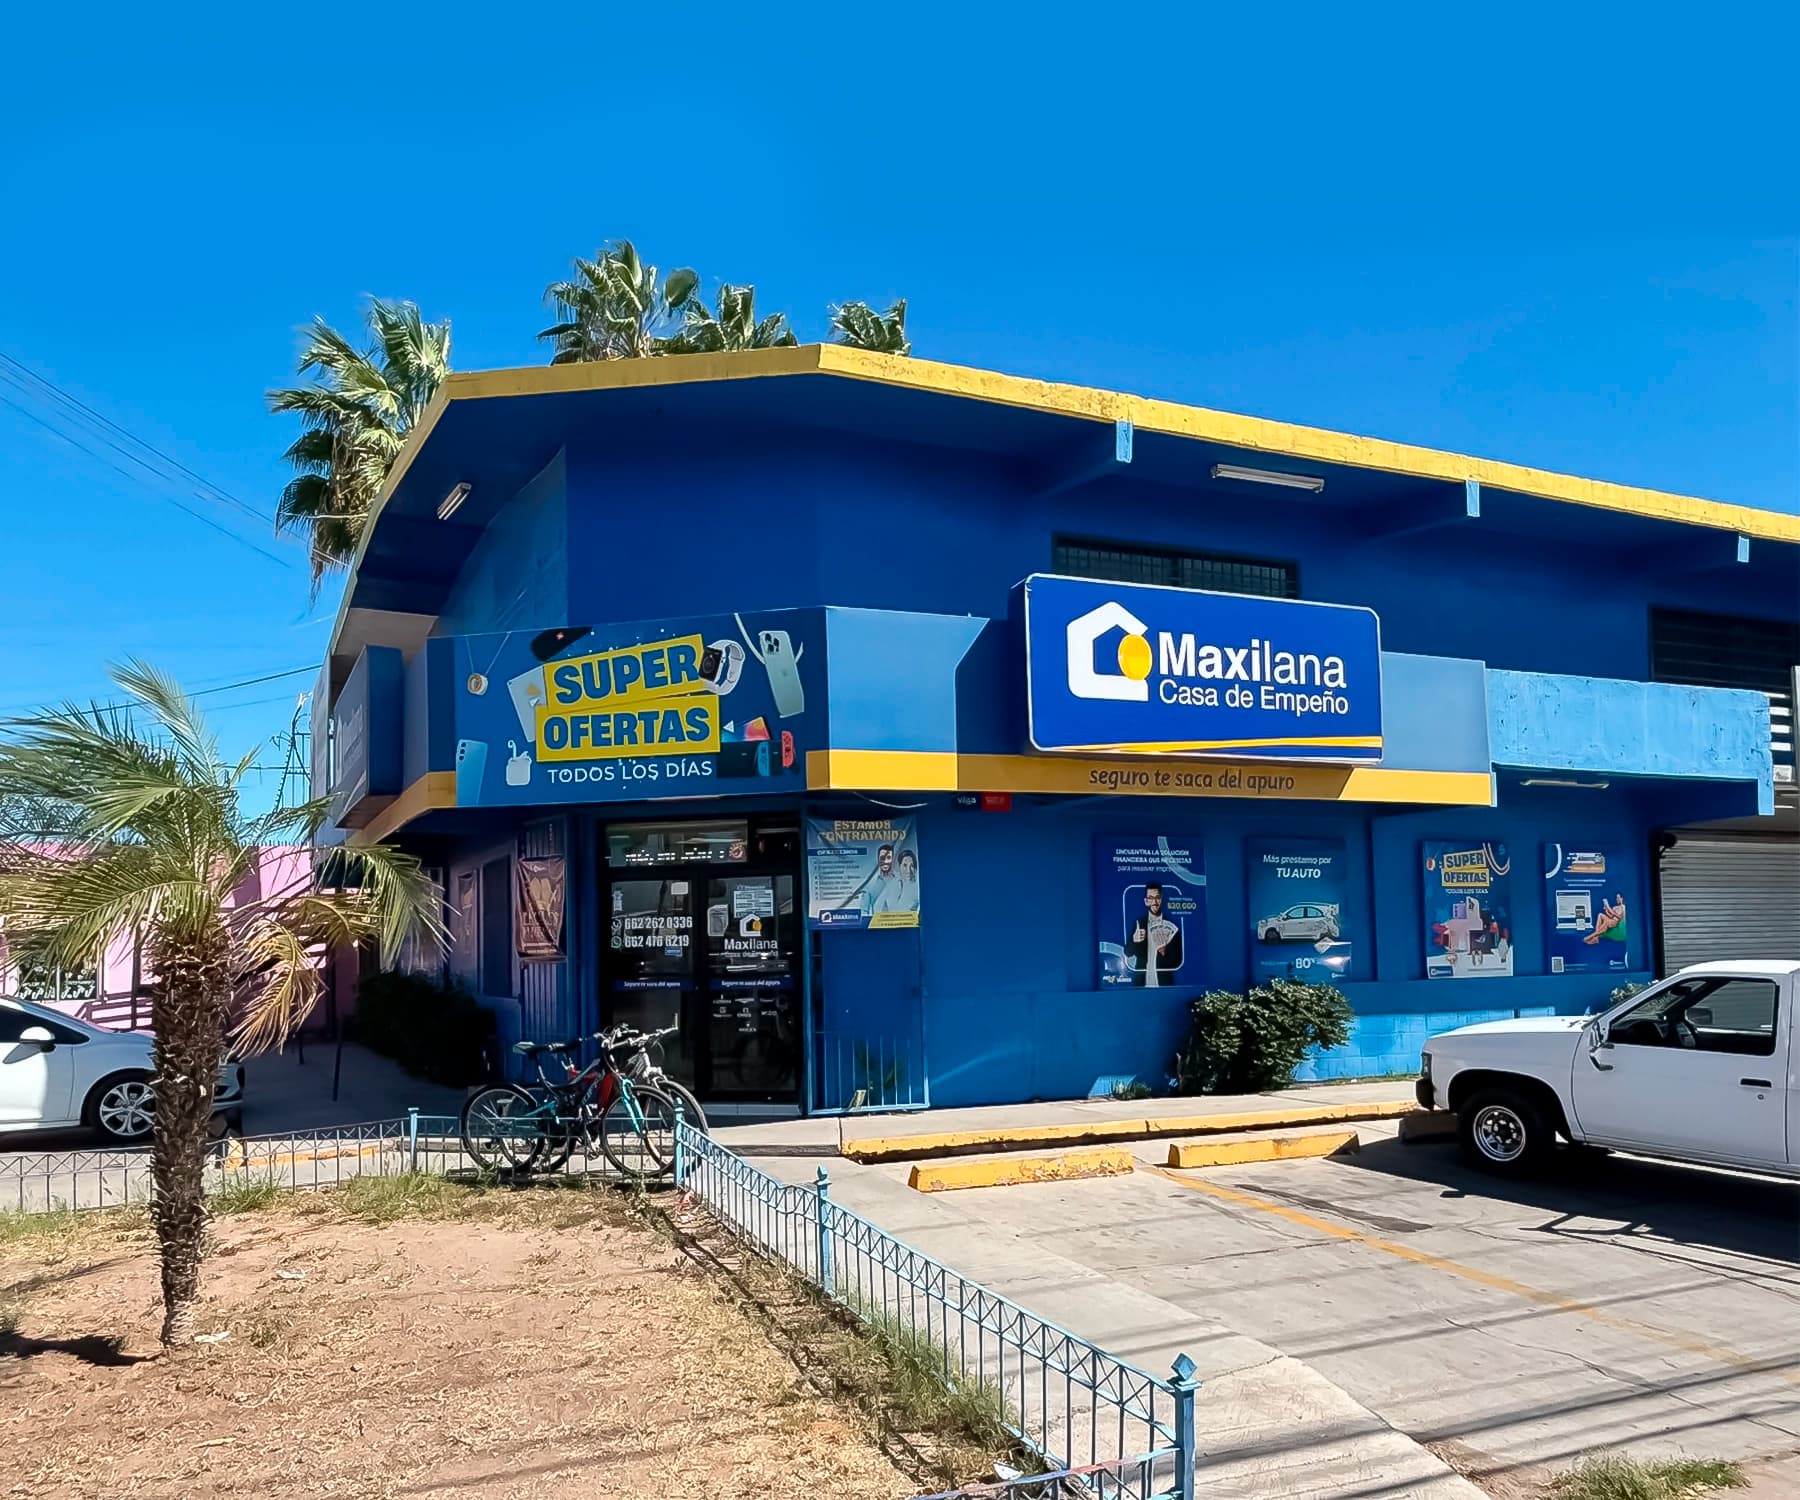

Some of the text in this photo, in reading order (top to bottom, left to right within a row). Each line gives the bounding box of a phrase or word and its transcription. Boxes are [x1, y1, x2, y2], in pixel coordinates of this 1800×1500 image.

[1158, 631, 1347, 689] Maxilana
[553, 643, 699, 705] SUPER
[1159, 679, 1349, 717] Casa de Empeño
[543, 707, 711, 751] OFERTAS
[547, 758, 713, 783] TODOS LOS DÍAS
[1089, 769, 1295, 793] seguro te saca del apuro
[1446, 853, 1484, 869] SUPER
[1276, 868, 1321, 879] TU AUTO
[1444, 871, 1487, 883] OFERTAS
[724, 938, 779, 951] Maxilana
